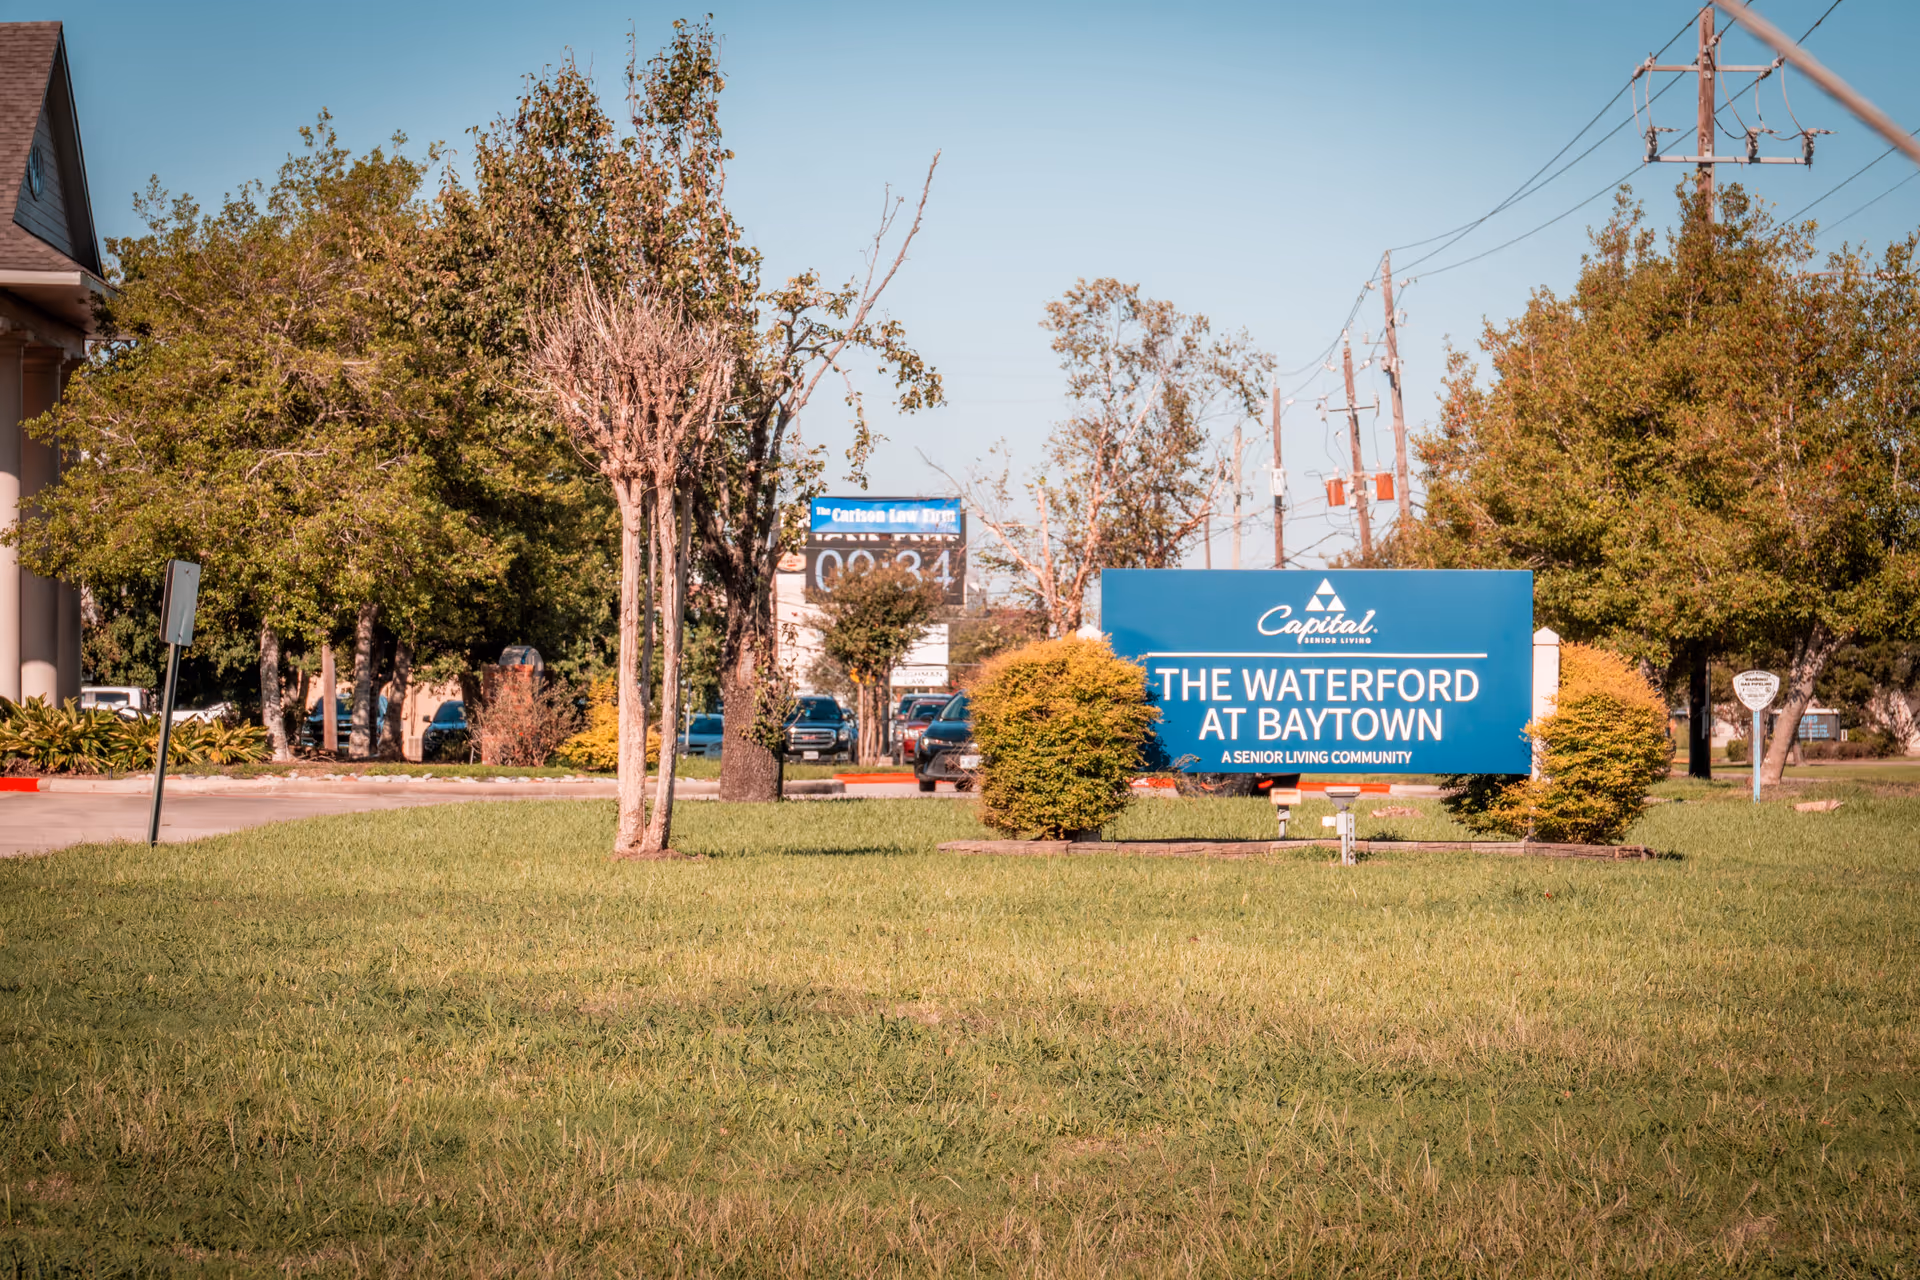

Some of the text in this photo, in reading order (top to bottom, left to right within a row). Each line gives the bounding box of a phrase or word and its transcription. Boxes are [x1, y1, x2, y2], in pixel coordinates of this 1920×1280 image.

[816, 506, 956, 523] The Carlson Law Firm
[1257, 604, 1376, 645] Capital
[1155, 668, 1479, 702] THE WATERFORD
[1199, 708, 1443, 741] AT BAYTOWN
[1221, 750, 1412, 765] A SENIOR LIVING COMMUNITY
